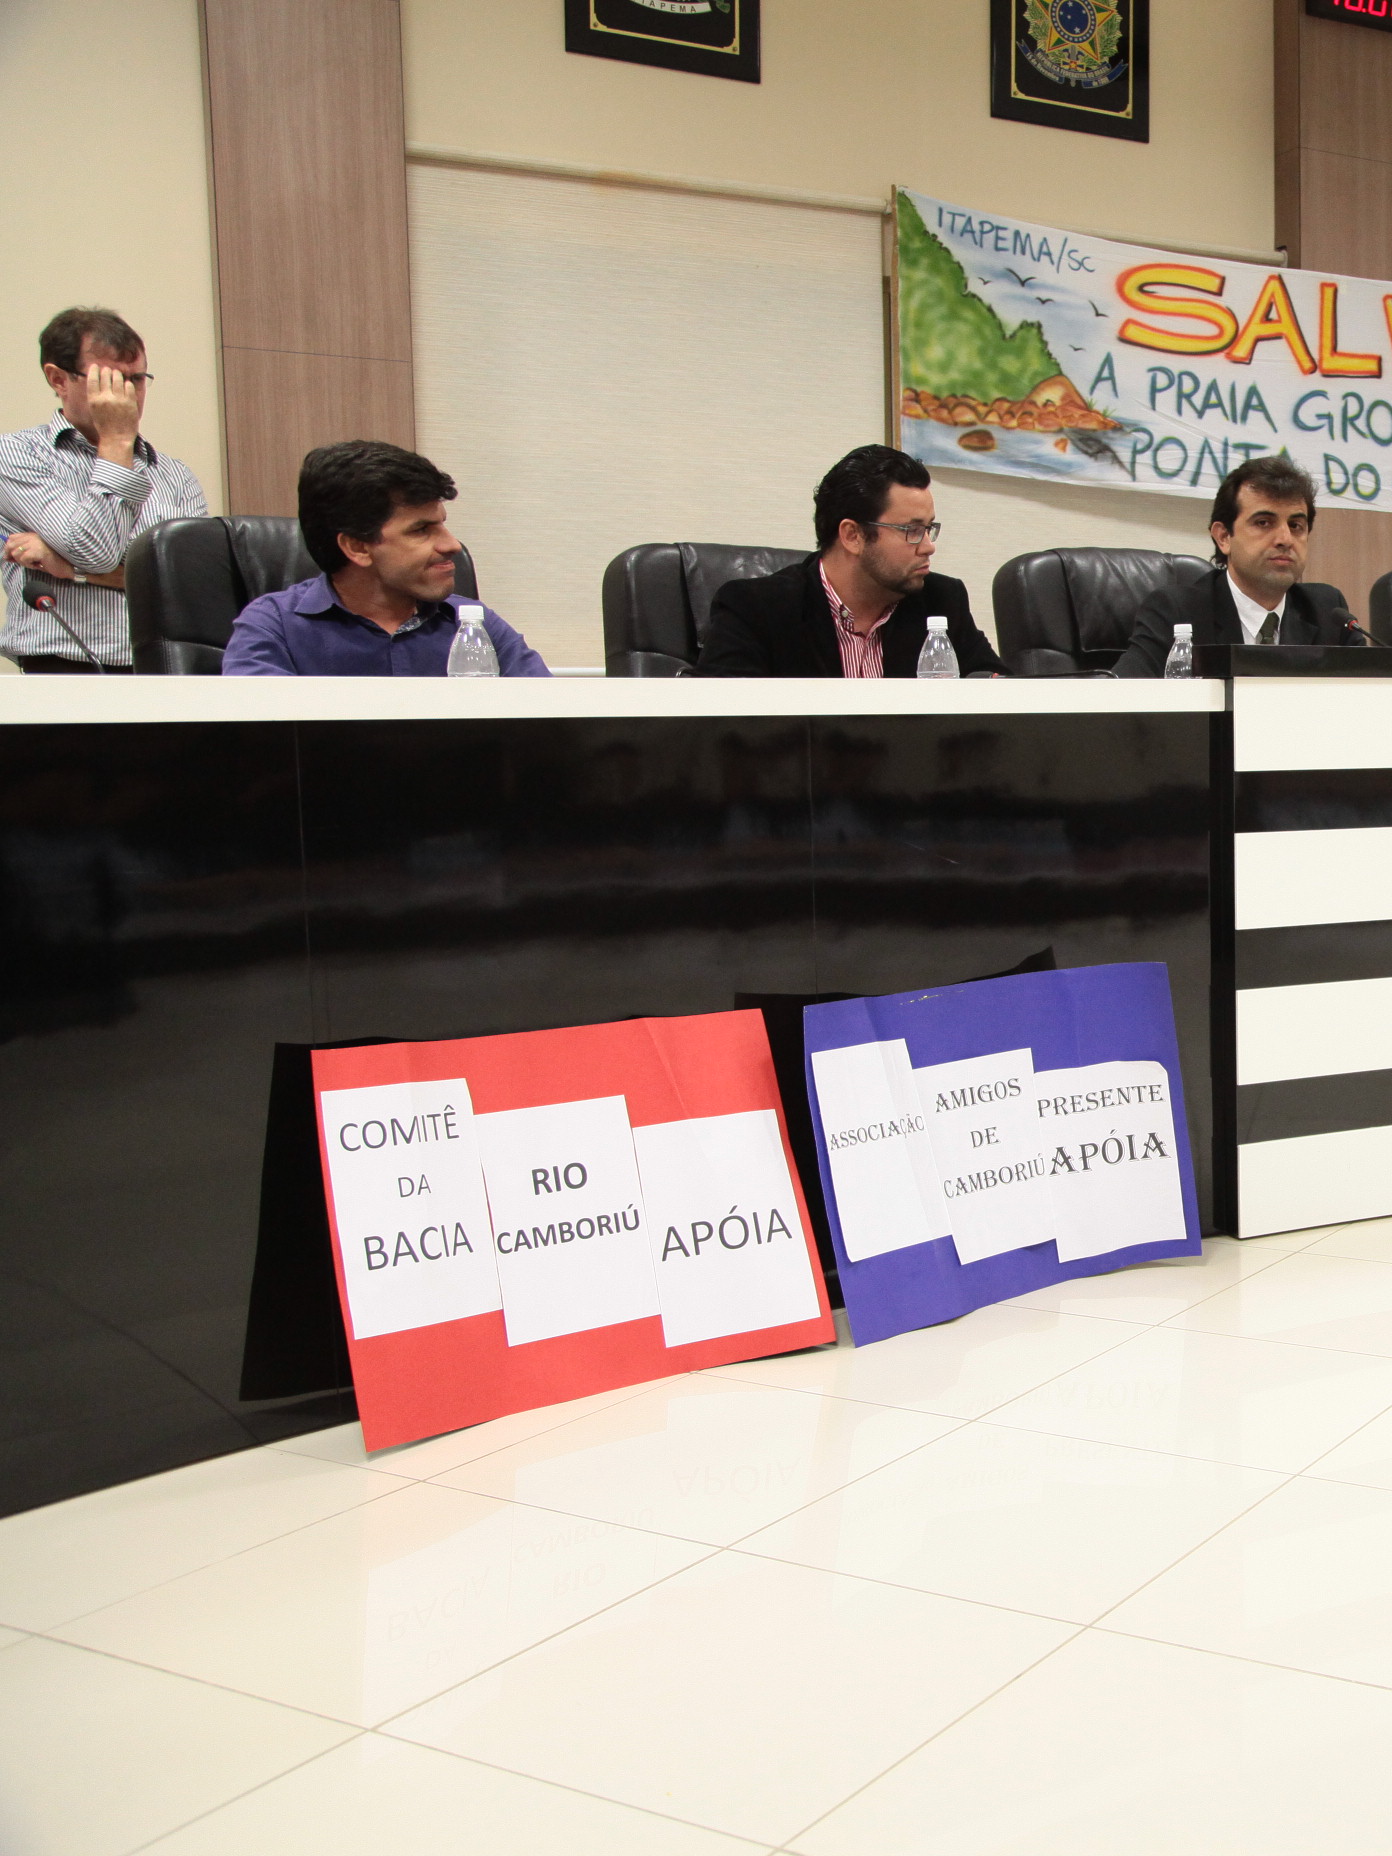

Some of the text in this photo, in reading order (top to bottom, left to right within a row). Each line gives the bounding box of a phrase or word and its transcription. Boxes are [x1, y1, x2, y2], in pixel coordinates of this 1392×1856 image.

[938, 206, 1095, 274] ITAPEMA/SC
[1090, 352, 1118, 398] A
[1147, 366, 1278, 433] PRAIA
[1130, 427, 1292, 487] PONT
[1323, 453, 1381, 500] DO
[936, 1077, 1022, 1113] AMIGOS
[1037, 1084, 1165, 1118] PRESENTE
[339, 1104, 460, 1152] COMITÊ
[830, 1113, 925, 1151] ASSOCIAÇÃO
[970, 1126, 999, 1149] DE
[943, 1152, 1045, 1199] CAMBORIÚ
[1049, 1129, 1172, 1176] APÓIA
[397, 1174, 432, 1198] DA
[531, 1162, 588, 1196] RIO
[363, 1222, 474, 1271] BACIA
[496, 1204, 641, 1254] CAMBORIÚ
[661, 1206, 793, 1262] APÓIA
